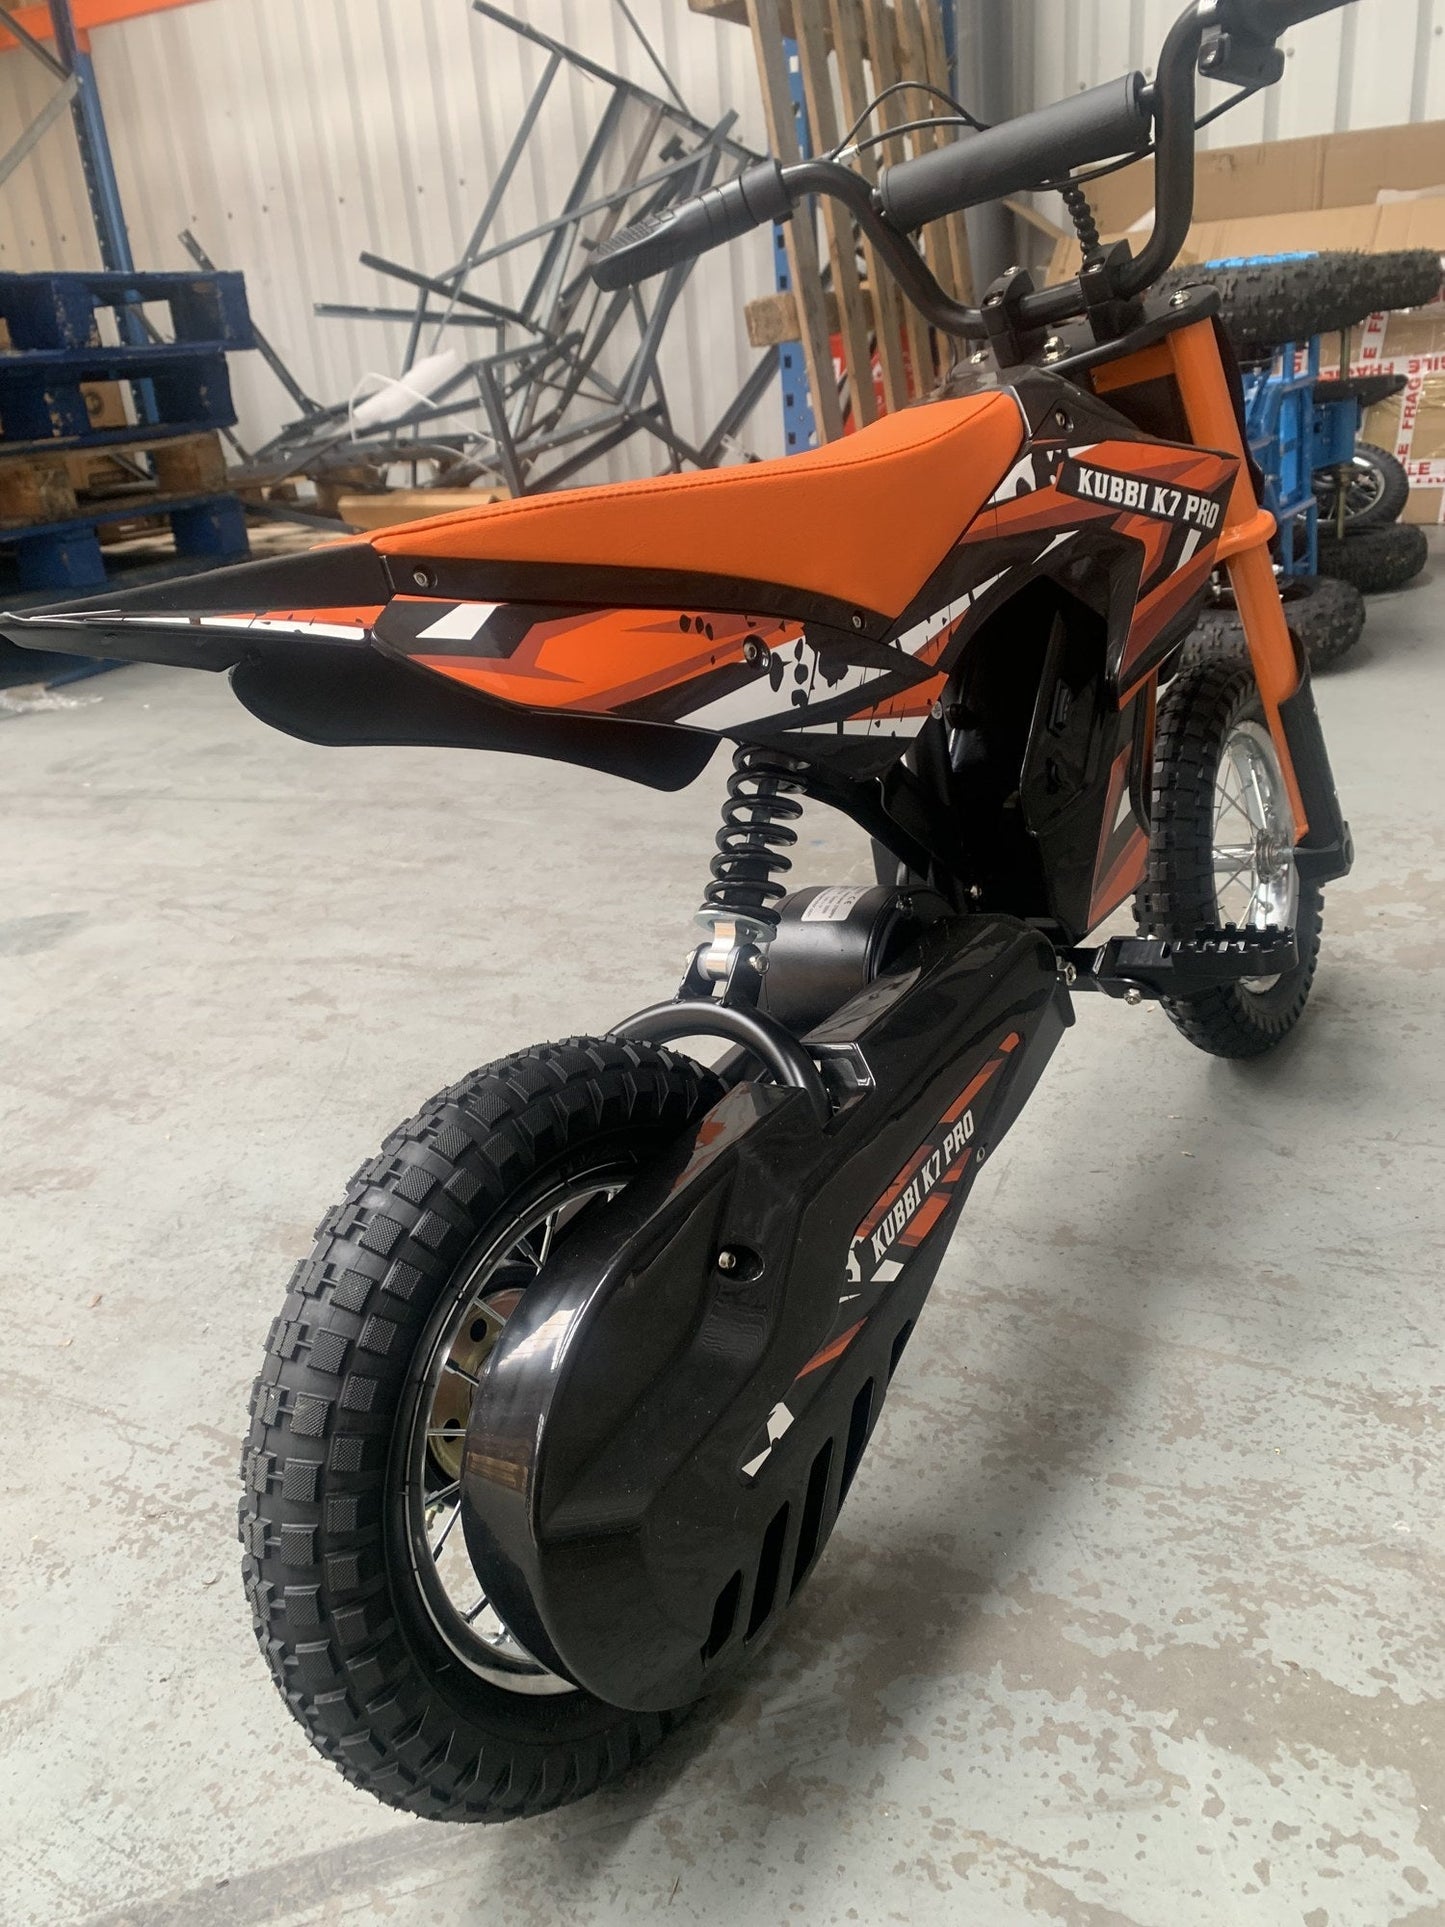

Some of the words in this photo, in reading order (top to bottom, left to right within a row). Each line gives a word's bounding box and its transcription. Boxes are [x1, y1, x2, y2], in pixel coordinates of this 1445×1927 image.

[1077, 466, 1149, 510] KUBBI
[1151, 486, 1182, 517] K7
[1182, 494, 1221, 529] PRO
[870, 1178, 922, 1264] KUBBI
[921, 1149, 941, 1194] K7
[942, 1108, 975, 1166] PRO
